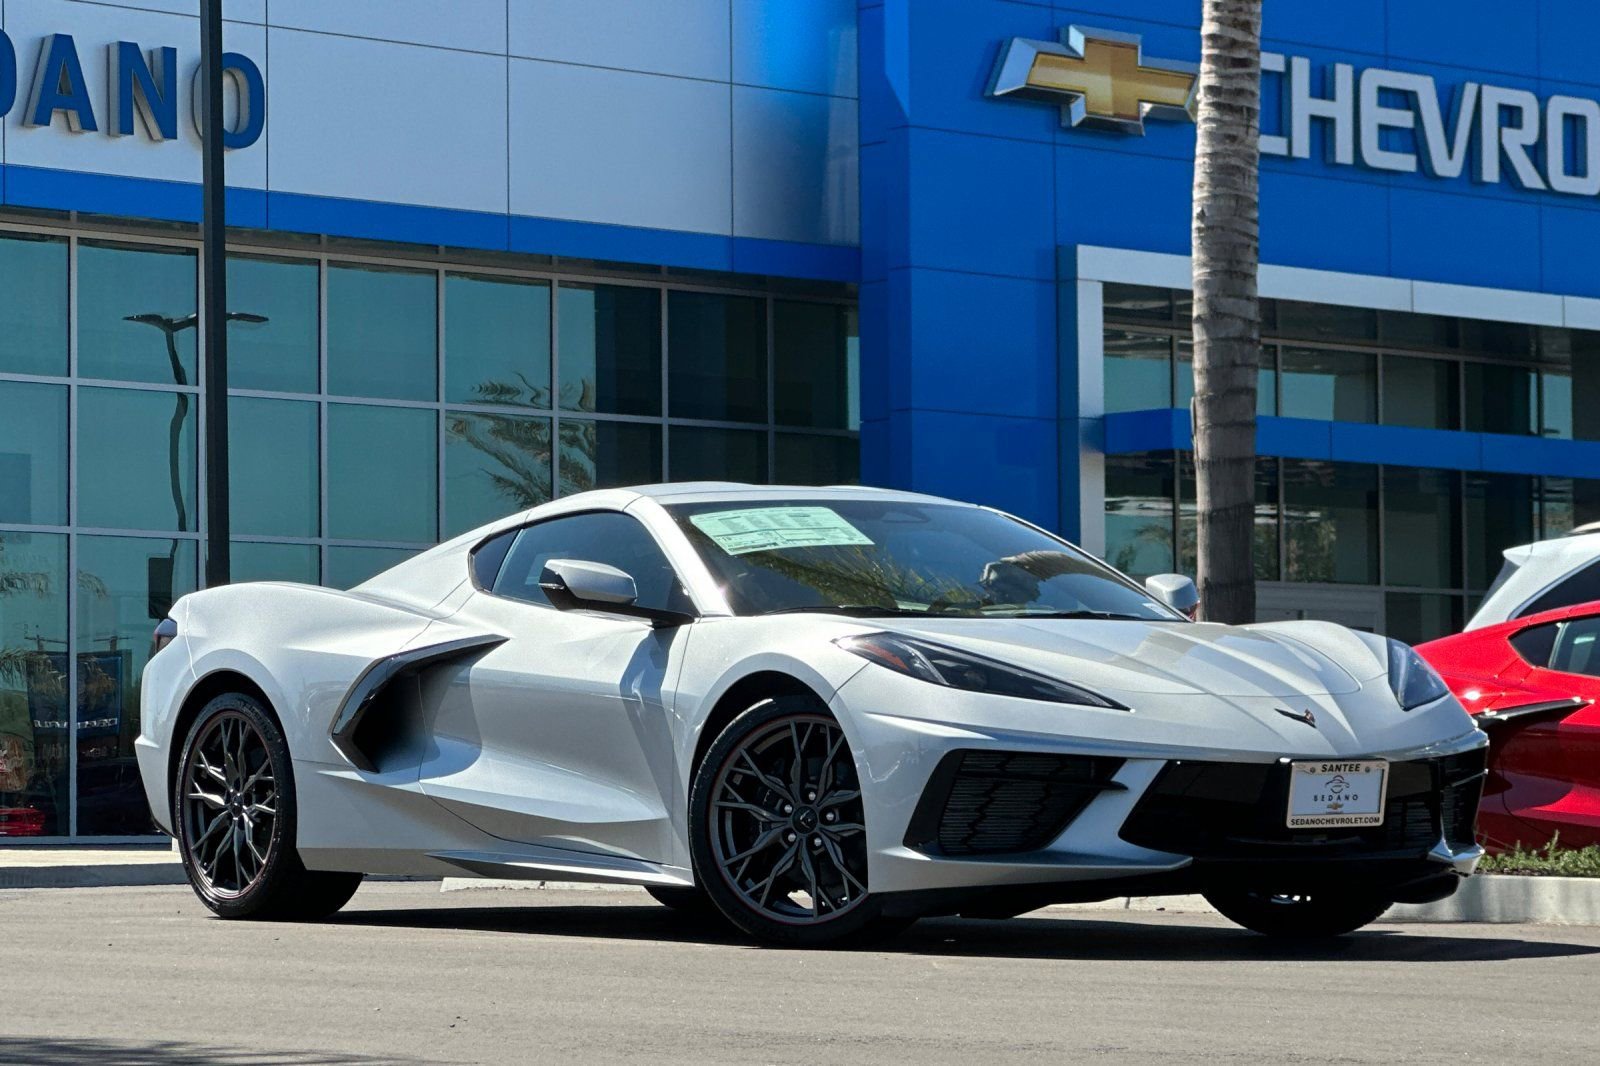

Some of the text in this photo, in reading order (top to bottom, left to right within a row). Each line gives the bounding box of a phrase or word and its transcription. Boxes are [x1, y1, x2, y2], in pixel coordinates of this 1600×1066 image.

[1321, 764, 1361, 772] SANTEE
[1313, 794, 1359, 802] SEDANO
[1291, 817, 1379, 825] SEDANOCHEVROLET.COM
